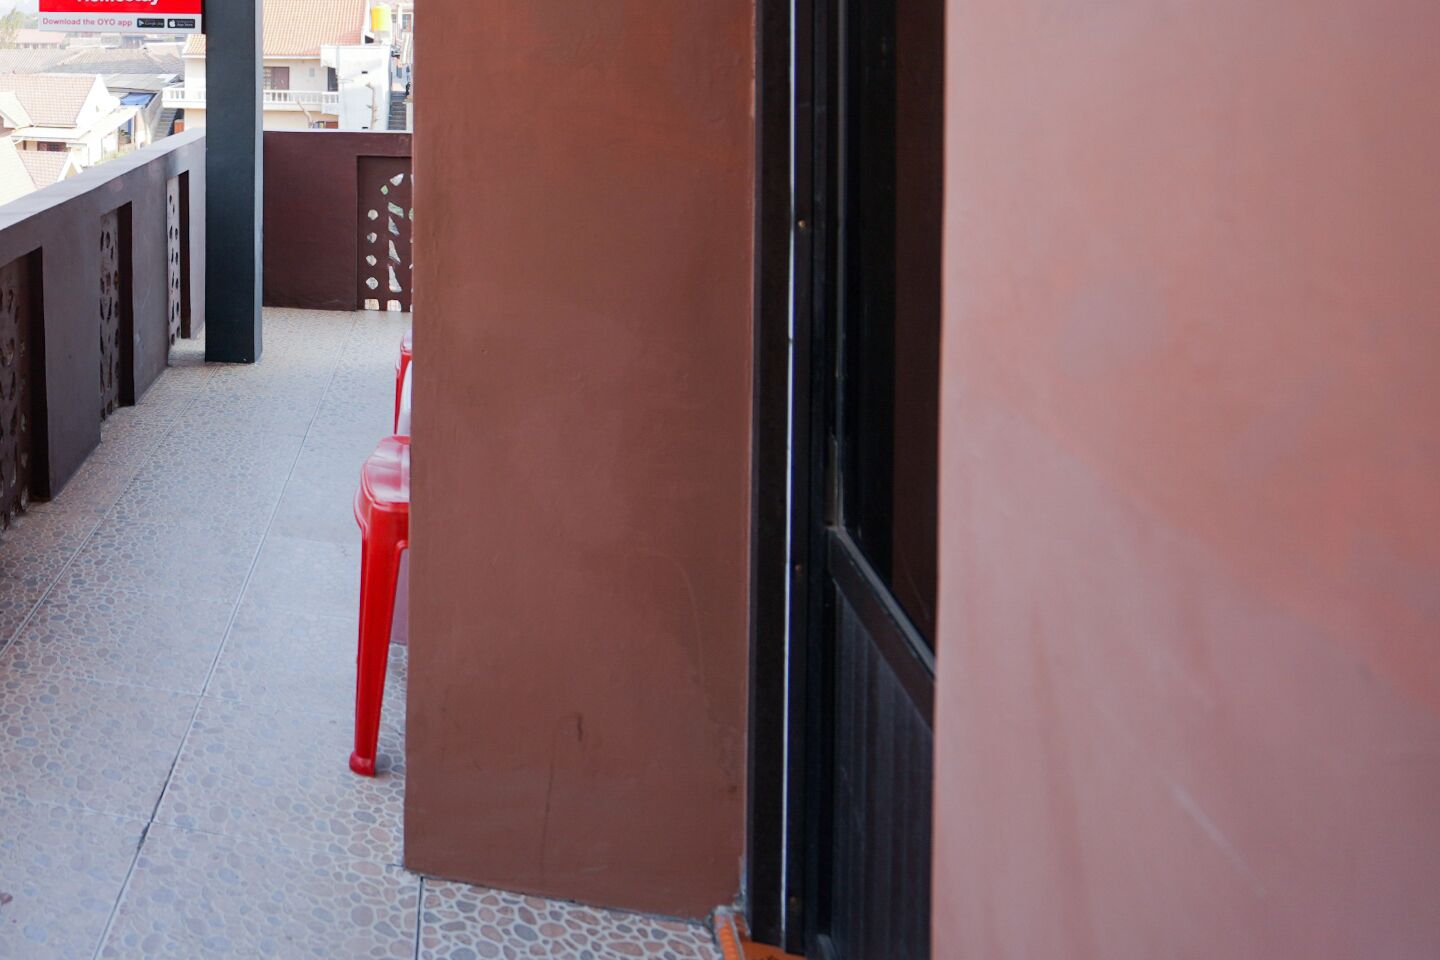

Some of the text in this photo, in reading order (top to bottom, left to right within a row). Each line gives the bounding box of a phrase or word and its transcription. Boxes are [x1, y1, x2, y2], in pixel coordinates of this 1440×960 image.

[42, 17, 133, 27] Download the OYO app
